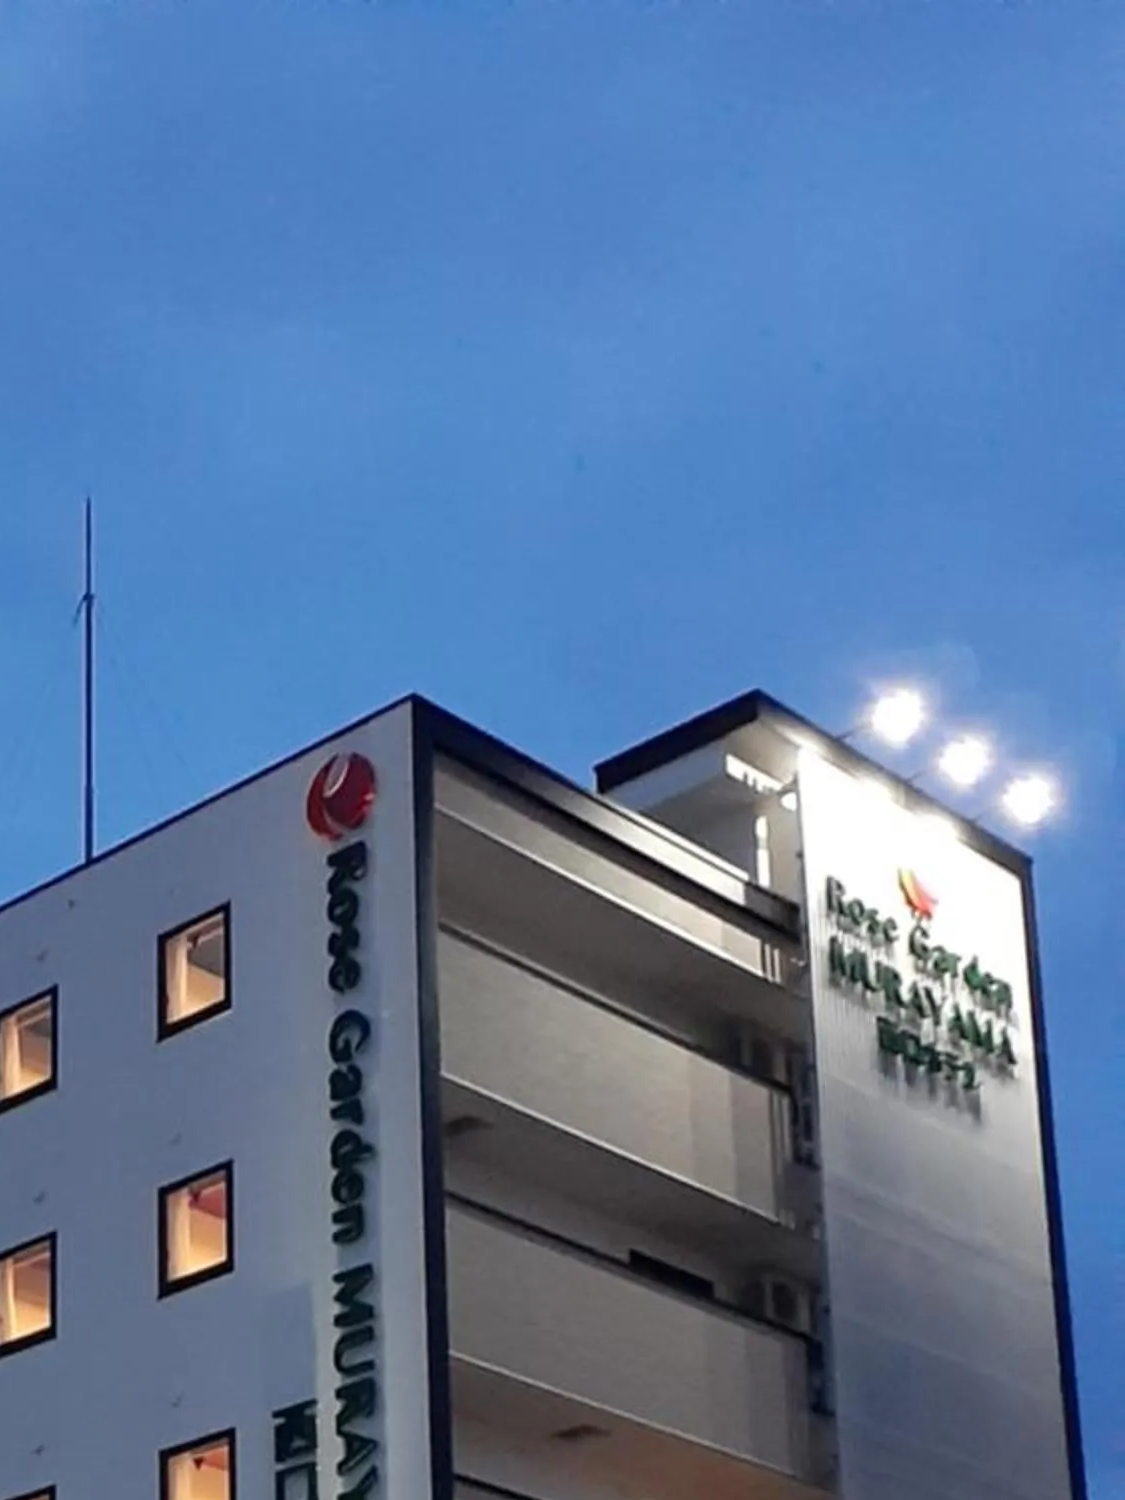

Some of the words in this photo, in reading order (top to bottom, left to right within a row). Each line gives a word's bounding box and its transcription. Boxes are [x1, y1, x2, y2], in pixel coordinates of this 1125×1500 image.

[327, 839, 368, 992] Rose
[826, 875, 898, 944] Rose
[909, 923, 1013, 1011] Garden
[828, 935, 1017, 1066] MURAYAMA
[329, 1010, 376, 1244] Garden
